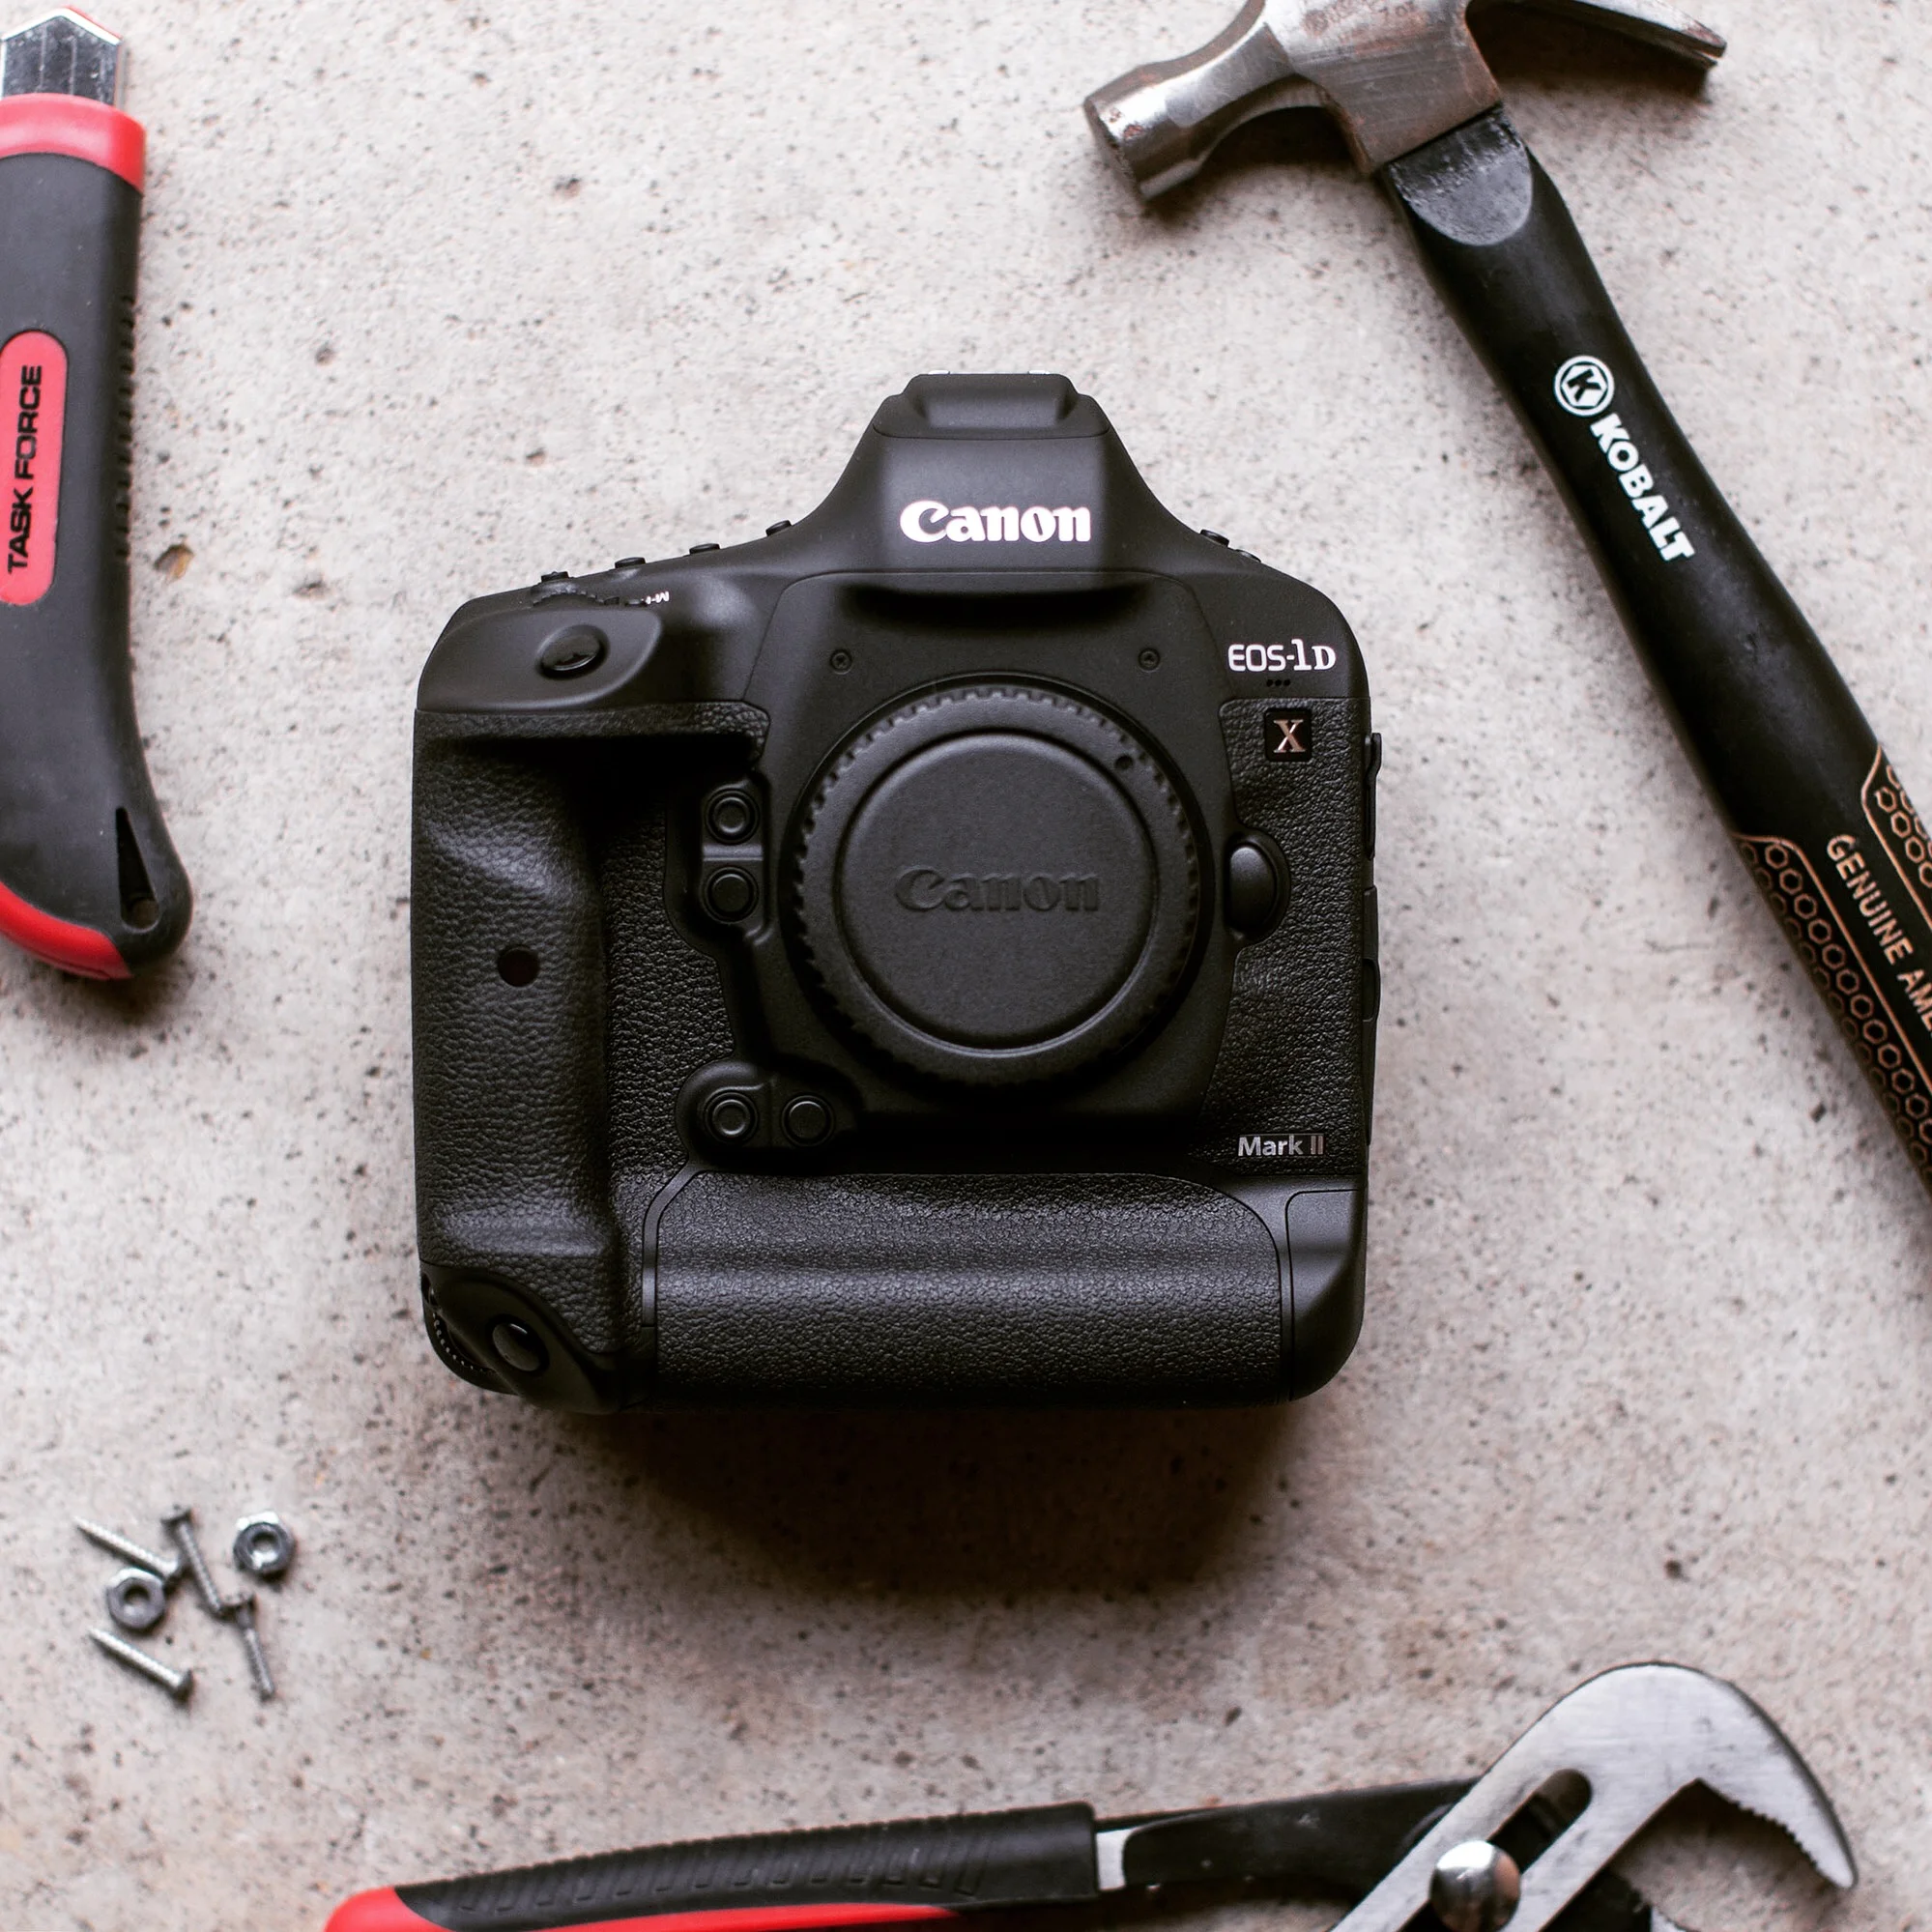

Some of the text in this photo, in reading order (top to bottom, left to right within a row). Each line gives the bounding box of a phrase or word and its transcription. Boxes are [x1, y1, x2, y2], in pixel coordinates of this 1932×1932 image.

[8, 365, 42, 574] TASK FORCE
[1590, 413, 1695, 562] KOBALT
[900, 500, 1091, 543] Canon
[1273, 719, 1306, 753] X
[895, 866, 1099, 911] Canon
[1826, 834, 1914, 966] GENUINE
[1237, 1134, 1324, 1157] Mark II
